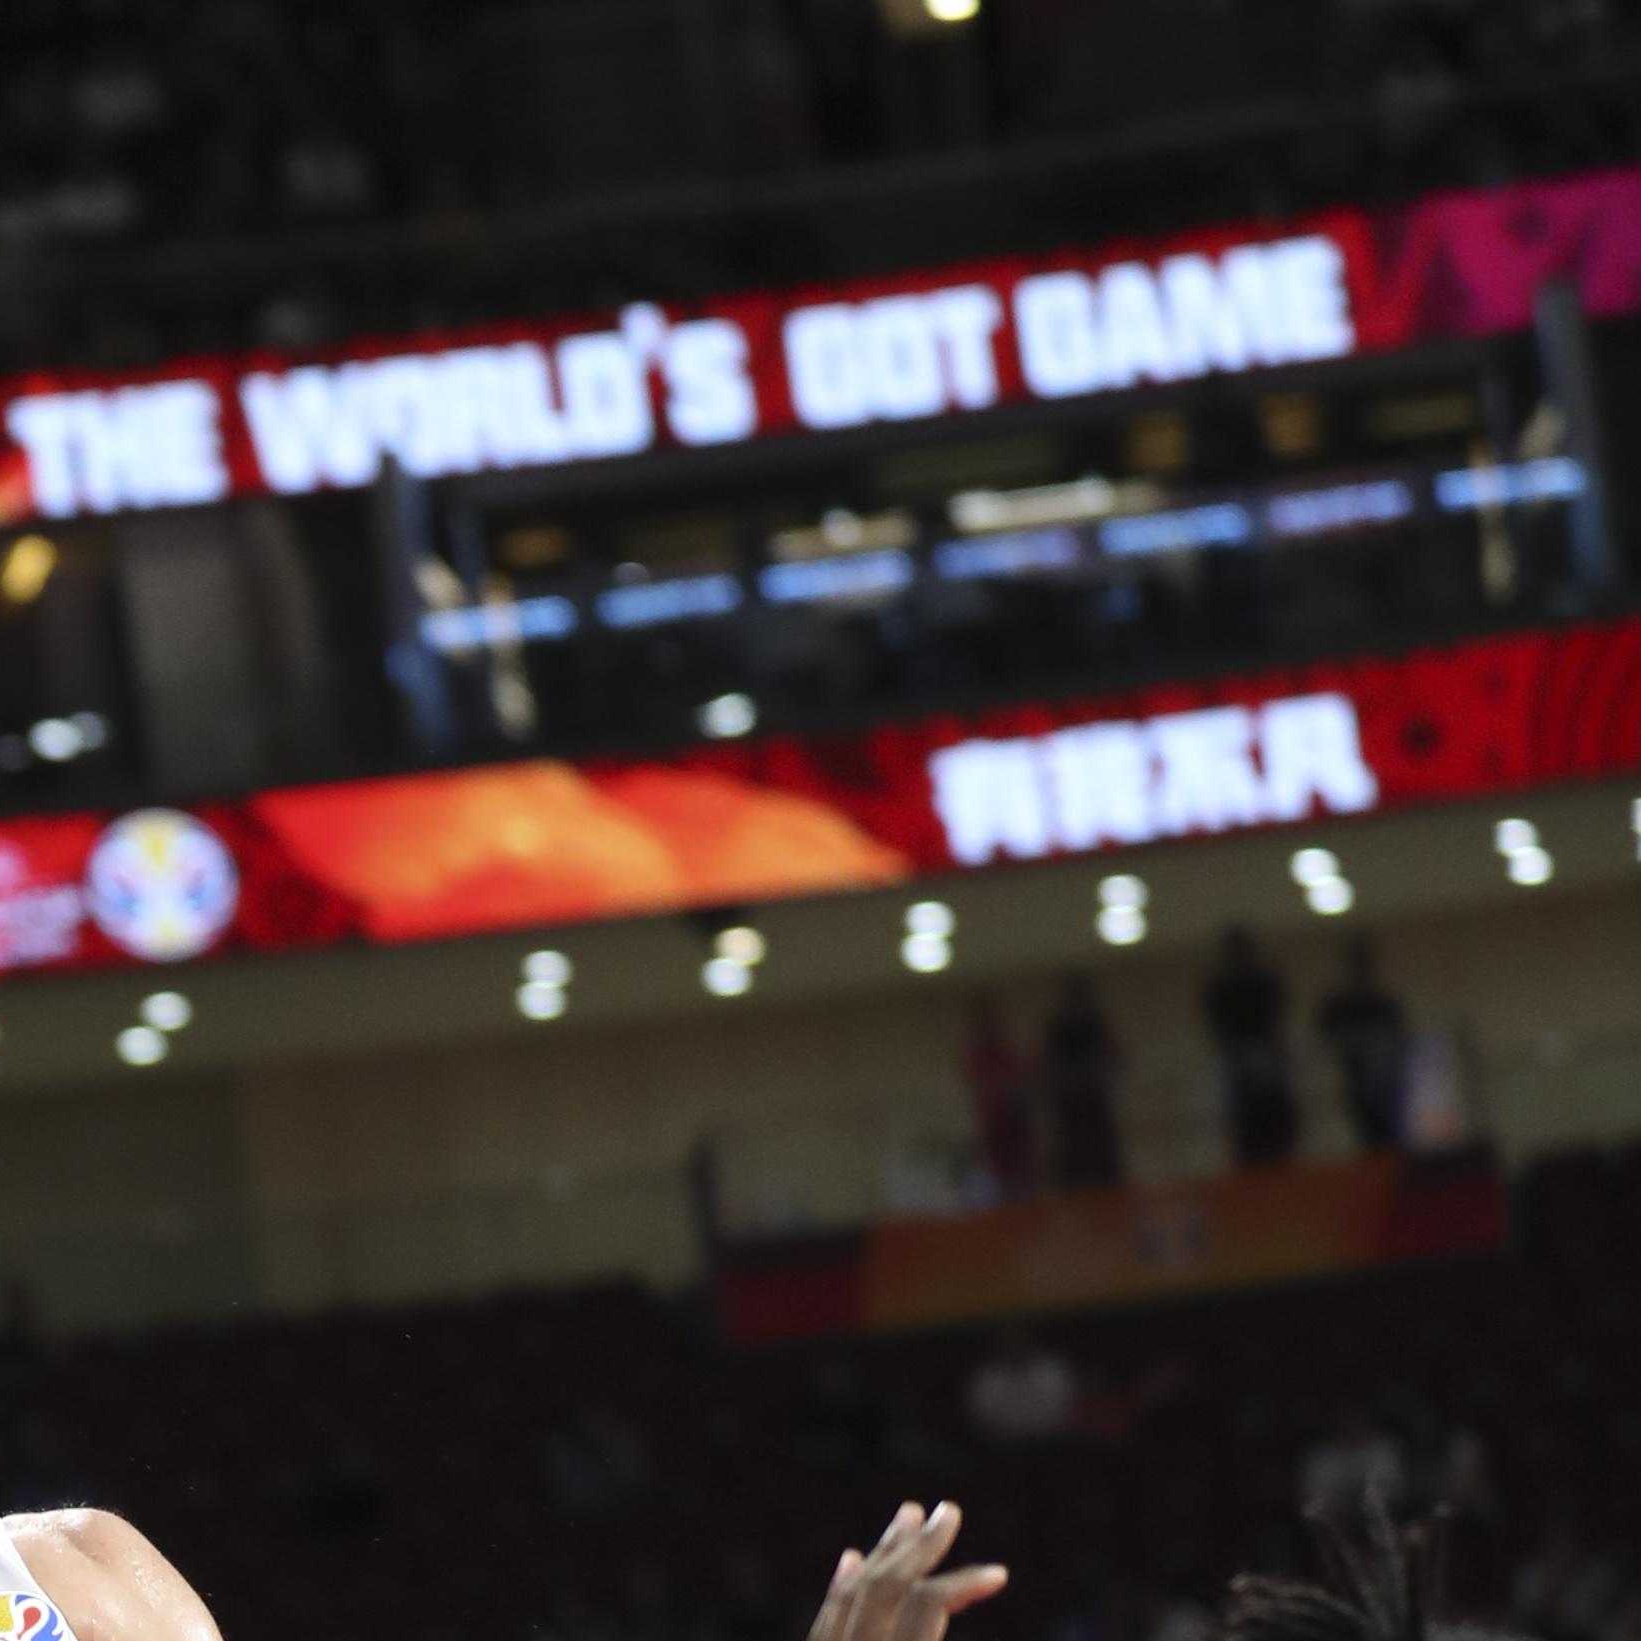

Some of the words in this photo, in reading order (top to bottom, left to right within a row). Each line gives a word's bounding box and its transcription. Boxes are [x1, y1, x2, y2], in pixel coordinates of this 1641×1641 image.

[9, 384, 228, 519] THE
[783, 283, 1003, 430] GOT
[1013, 234, 1355, 400] GAME
